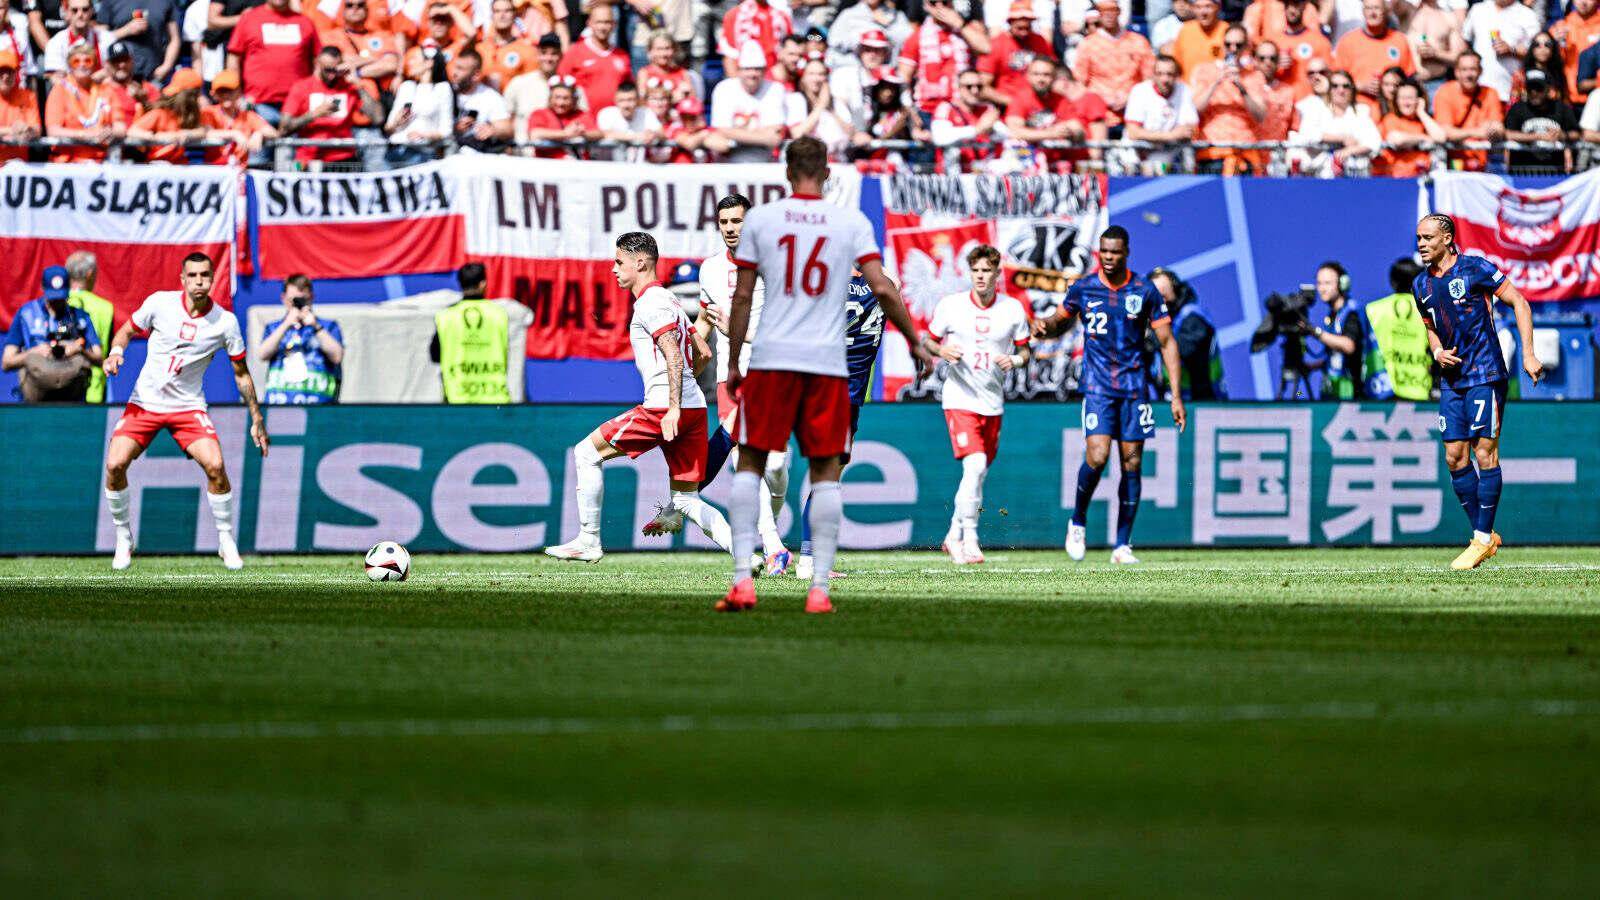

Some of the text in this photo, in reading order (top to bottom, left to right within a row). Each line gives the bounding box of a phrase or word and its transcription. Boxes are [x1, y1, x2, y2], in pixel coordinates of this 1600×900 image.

[87, 173, 223, 225] ŚLĄSKA
[494, 178, 561, 231] LM
[785, 210, 827, 225] BUKSA
[778, 233, 828, 297] 16
[845, 301, 885, 347] 24
[1085, 312, 1108, 335] 22
[168, 355, 184, 376] 14
[974, 352, 990, 370] 21
[1473, 399, 1486, 422] 7
[1062, 400, 1577, 545] 中国第一
